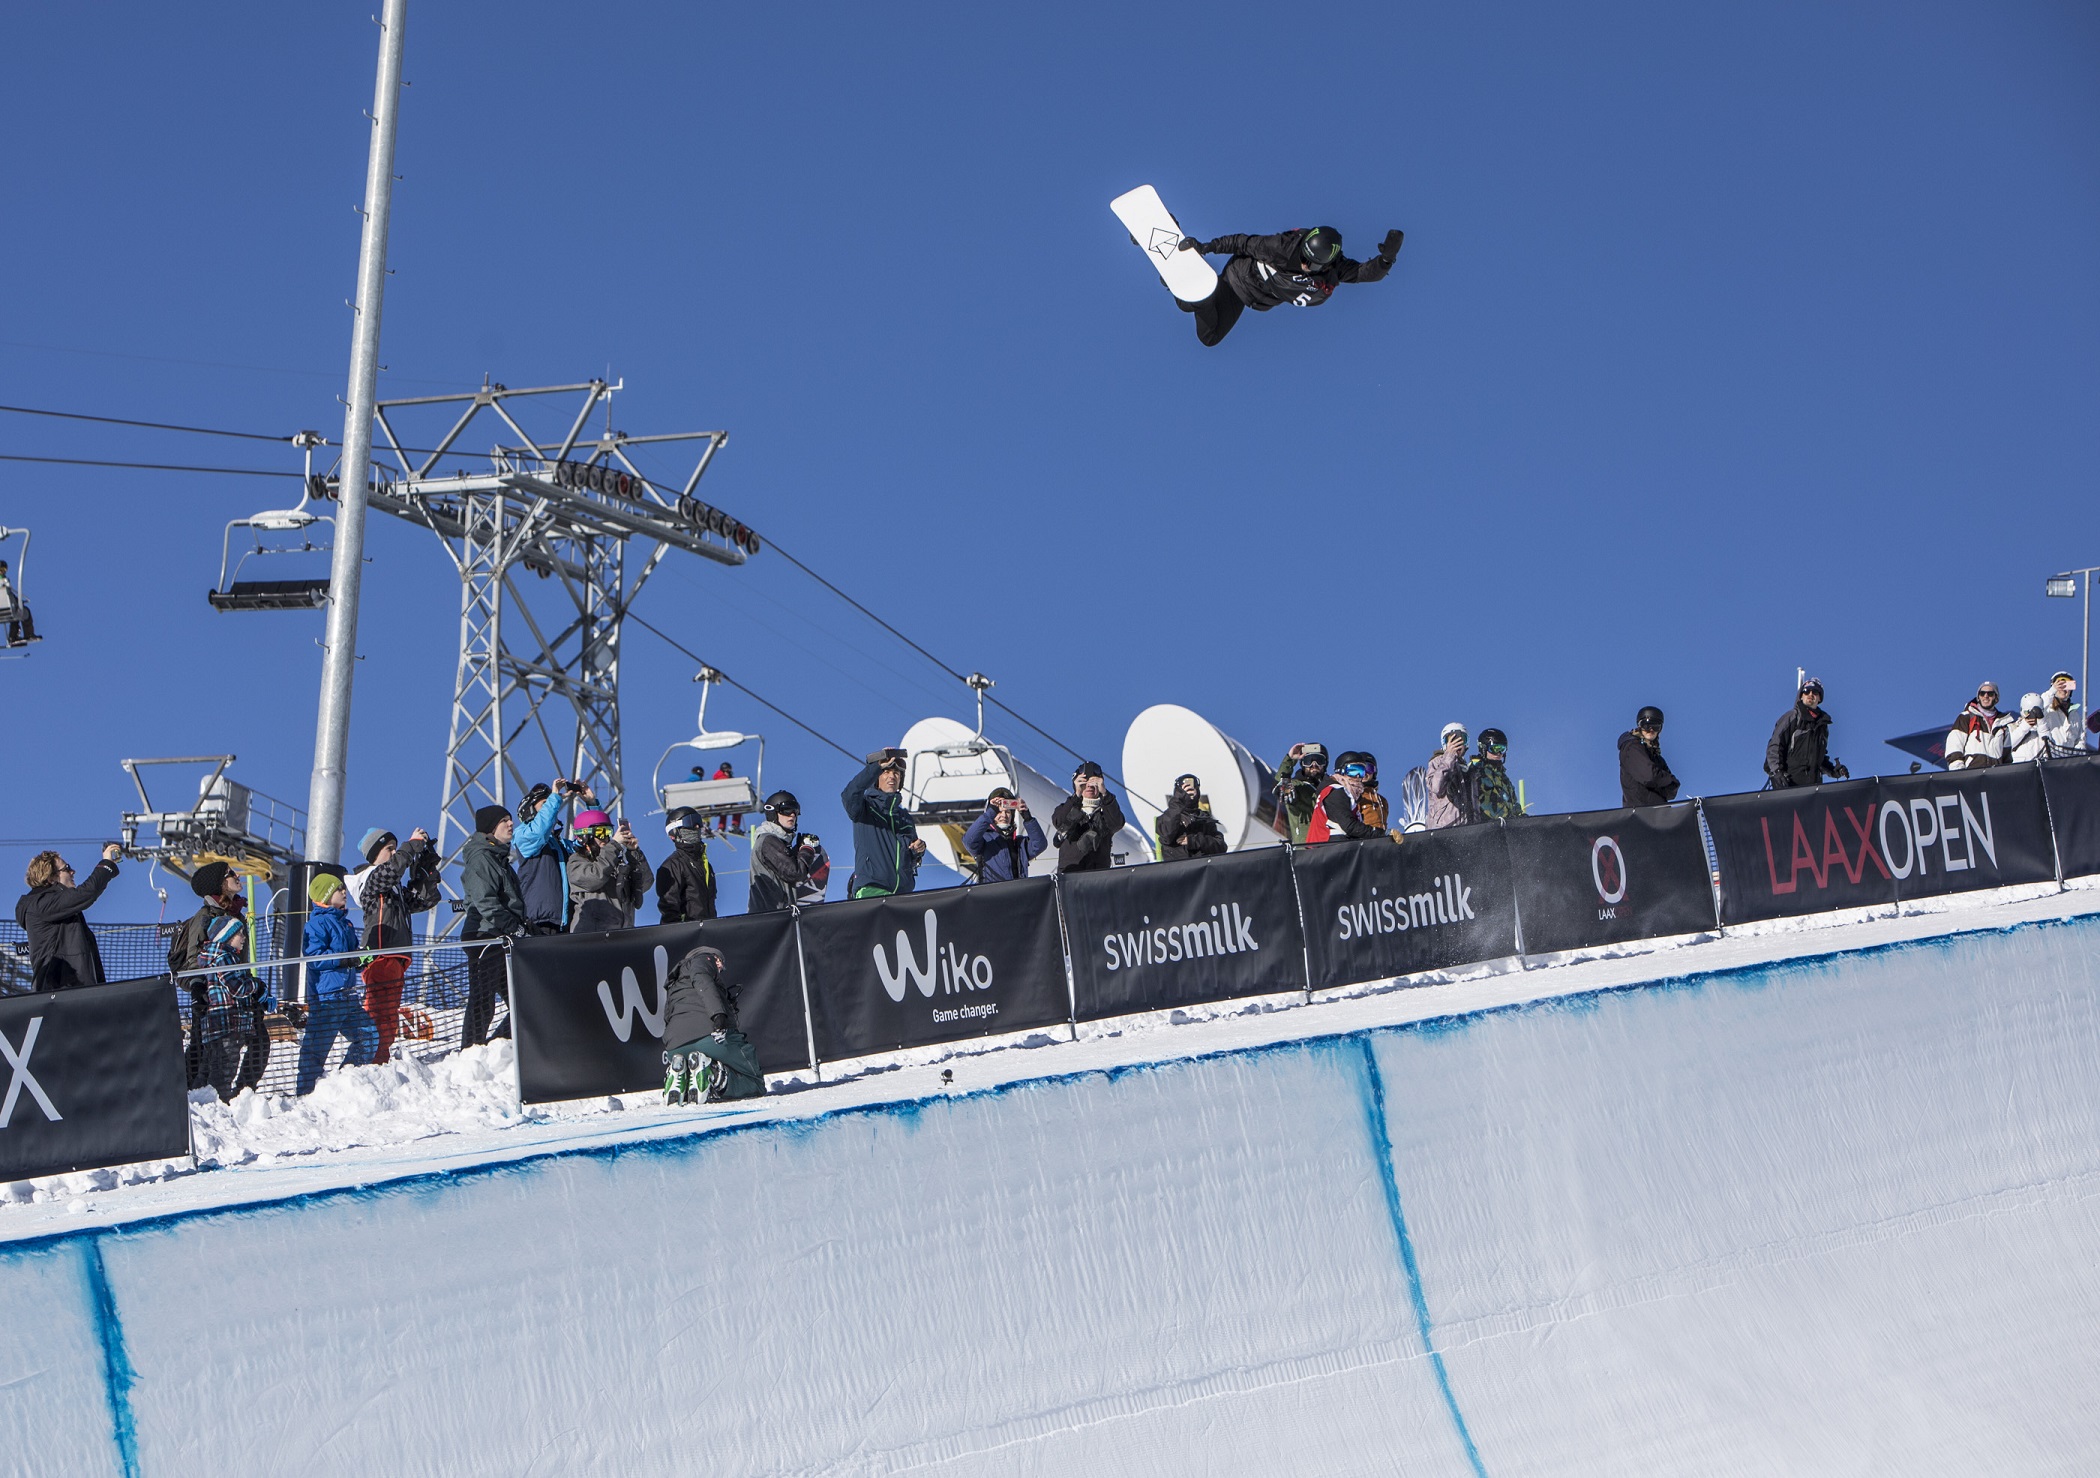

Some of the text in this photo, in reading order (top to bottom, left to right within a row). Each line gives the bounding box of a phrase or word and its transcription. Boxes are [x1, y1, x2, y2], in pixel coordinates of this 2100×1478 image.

[1760, 789, 1998, 896] LAAXOPEN
[161, 926, 175, 935] LAAX
[453, 903, 464, 911] LAA
[1103, 902, 1259, 971] swissmilk
[1337, 873, 1475, 940] swissmilk
[872, 908, 993, 1002] Wiko
[597, 944, 669, 1043] W
[932, 1003, 999, 1023] Game changer.
